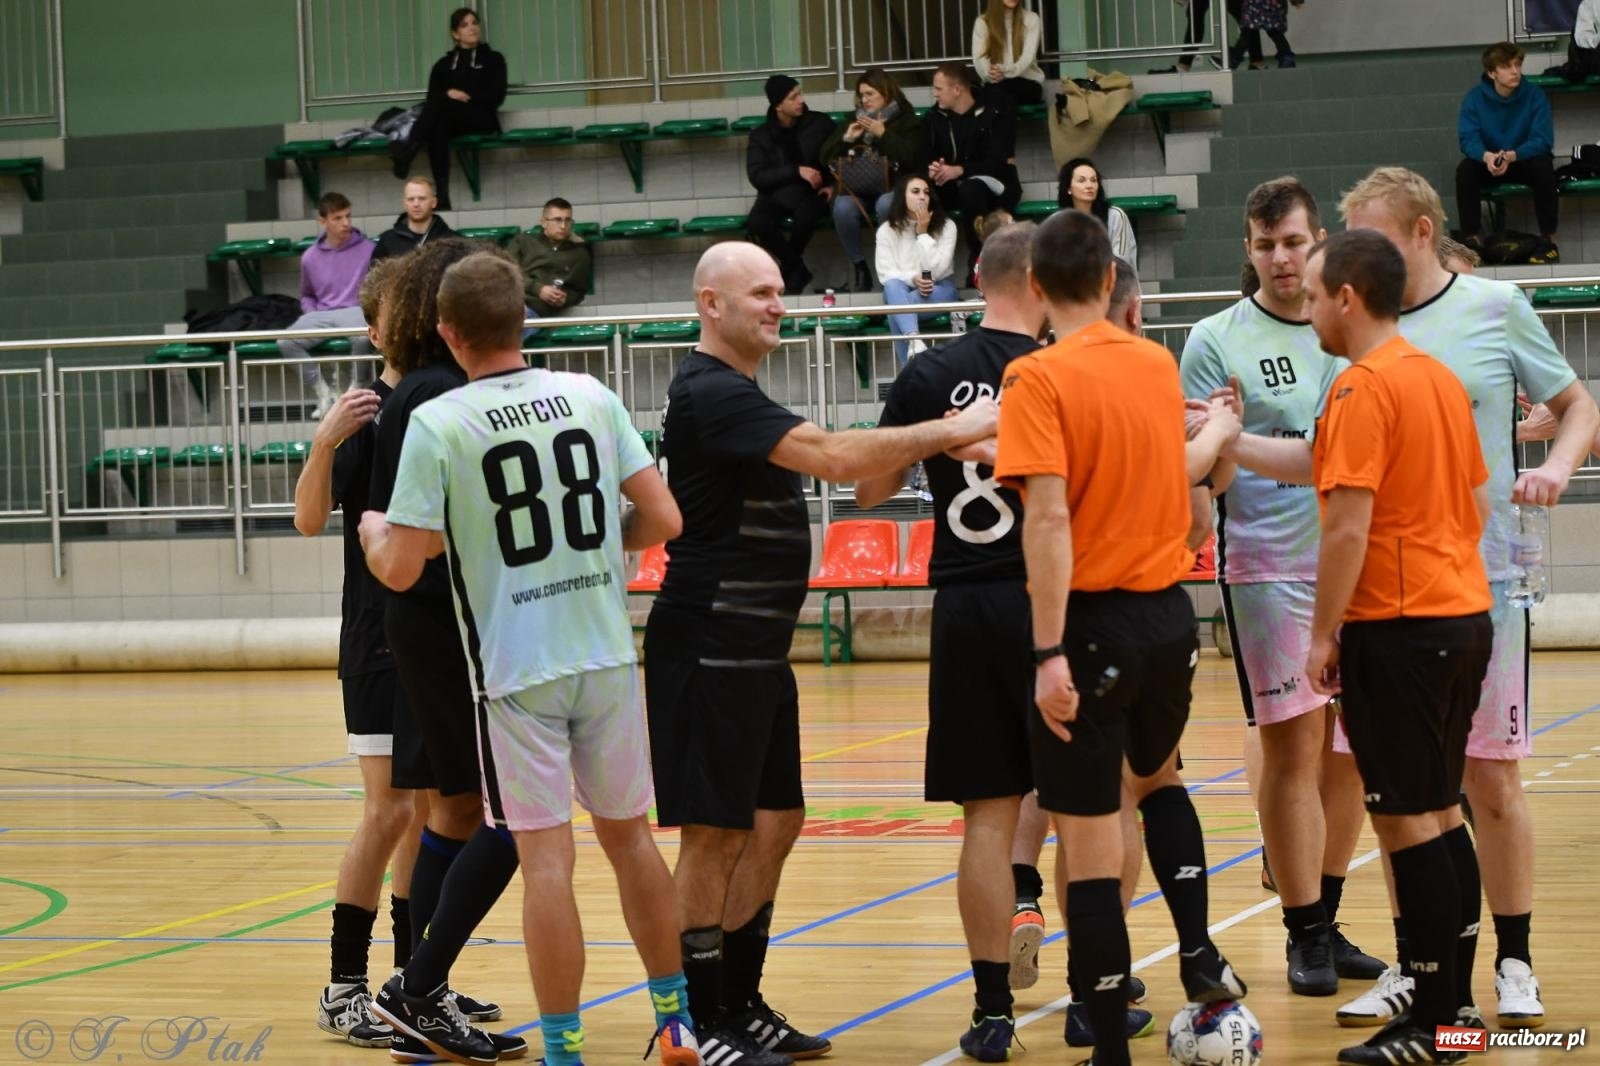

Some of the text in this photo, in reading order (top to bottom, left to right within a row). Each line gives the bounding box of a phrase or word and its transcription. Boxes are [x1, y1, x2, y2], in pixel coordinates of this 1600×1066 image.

[1260, 356, 1297, 388] 99
[486, 395, 573, 432] RAFCIO
[482, 428, 606, 568] 88
[947, 461, 1015, 544] 8
[1510, 705, 1518, 735] 9
